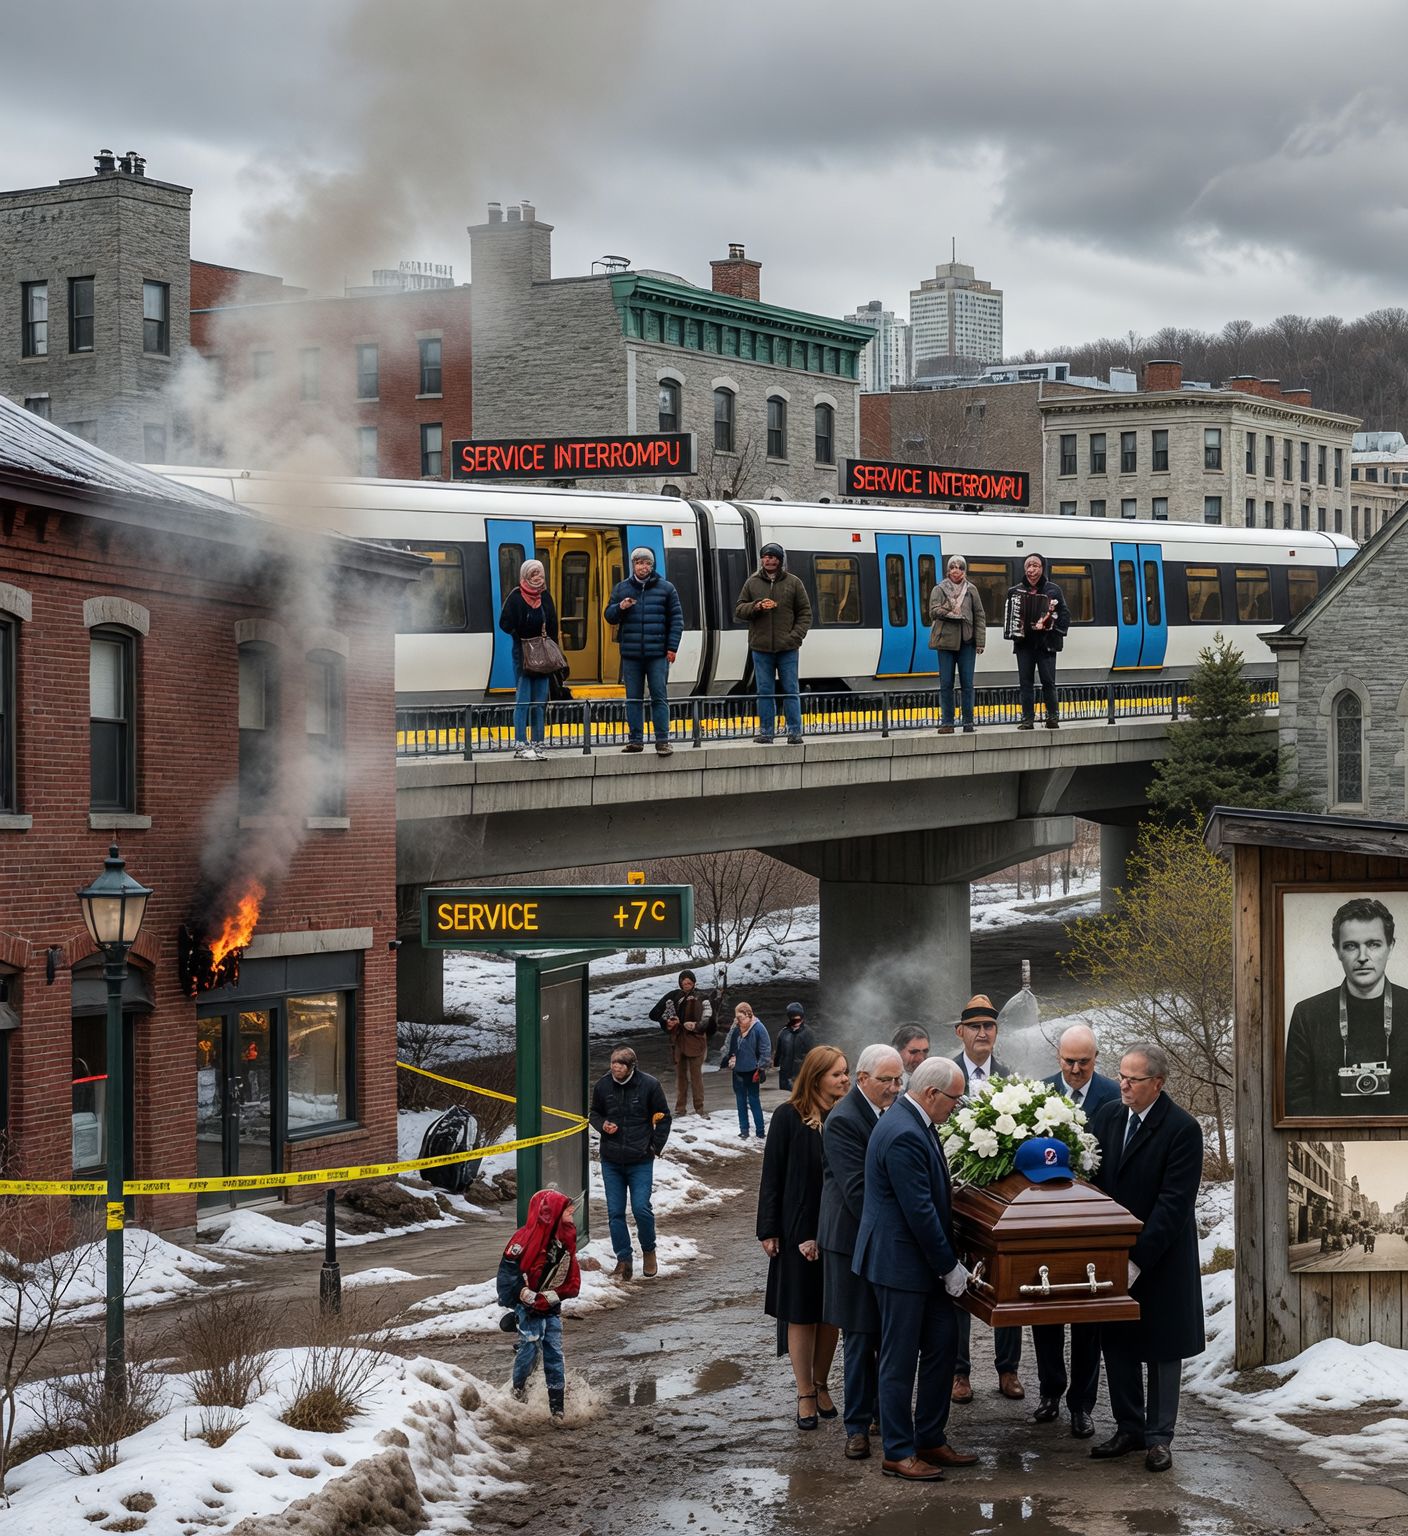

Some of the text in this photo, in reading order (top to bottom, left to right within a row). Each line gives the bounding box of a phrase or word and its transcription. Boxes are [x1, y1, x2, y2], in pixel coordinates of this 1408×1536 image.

[461, 441, 680, 472] SERVICE INTERROMPU
[853, 465, 922, 494] SERVICE
[437, 903, 539, 931] SERVICE
